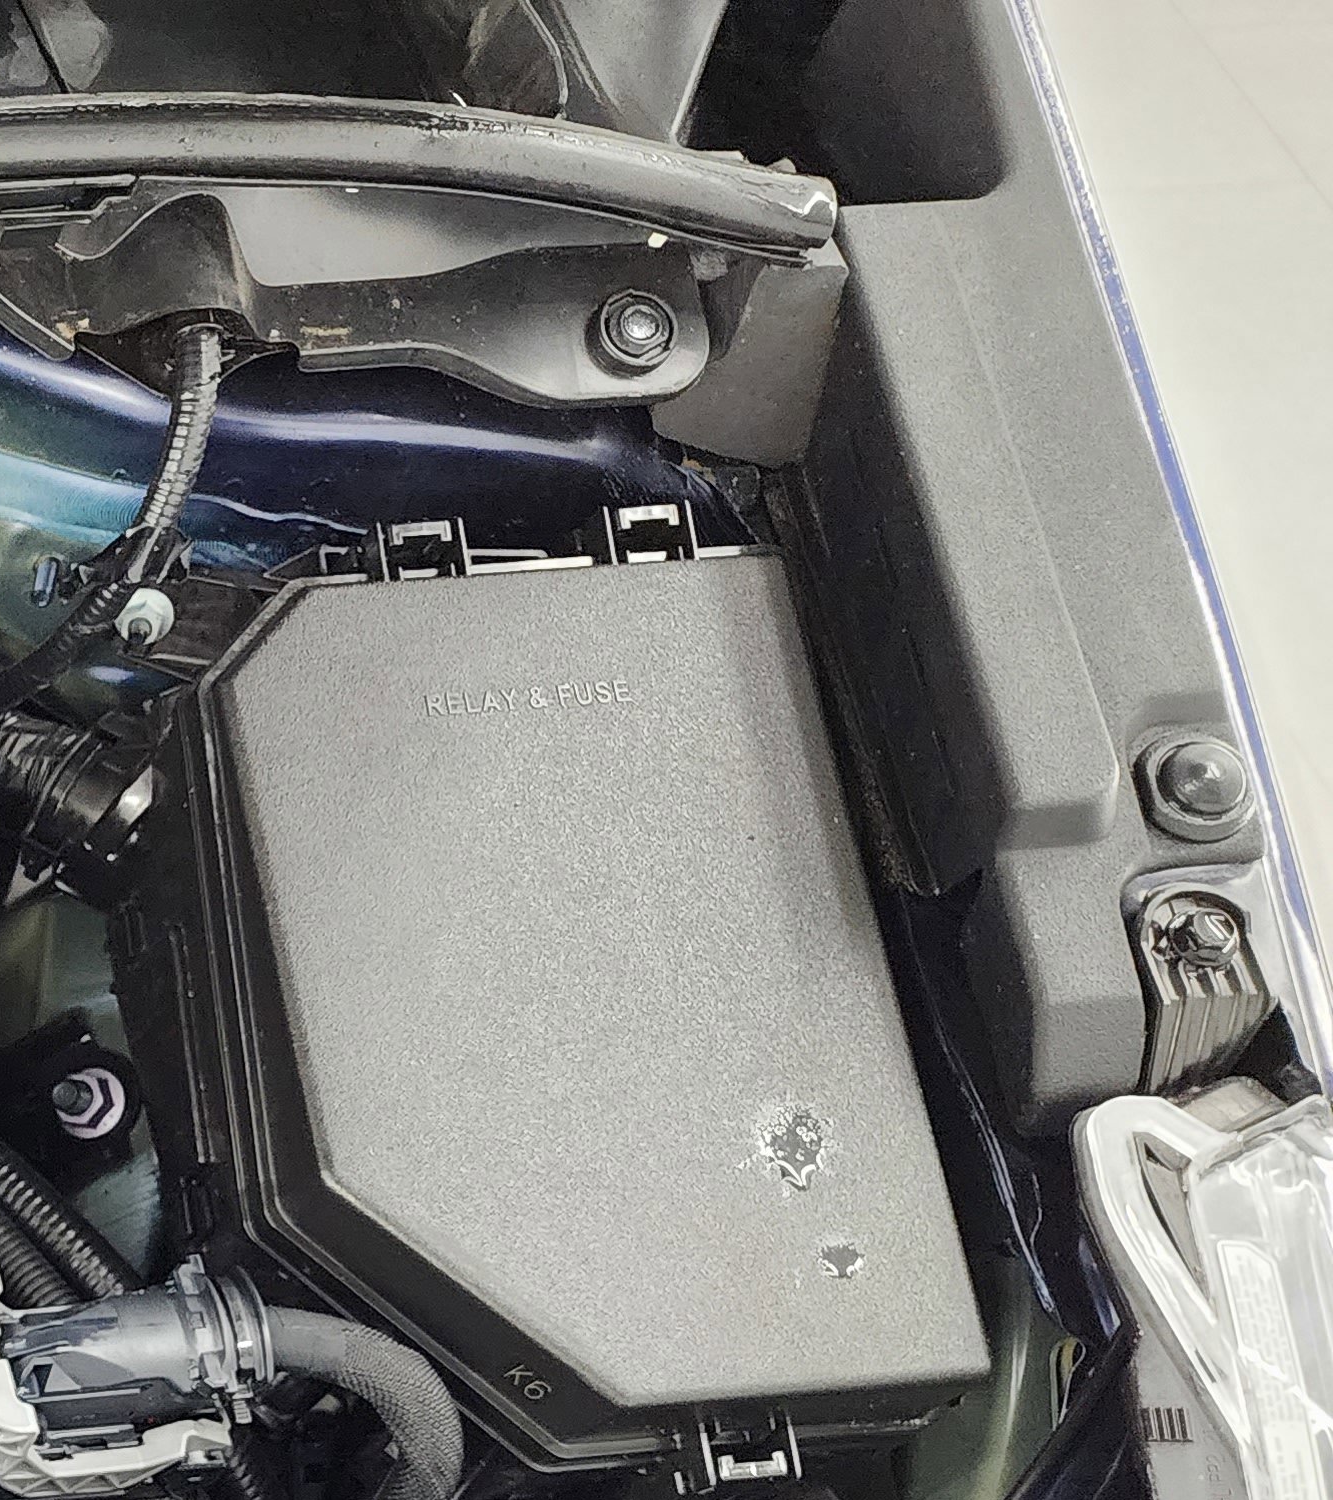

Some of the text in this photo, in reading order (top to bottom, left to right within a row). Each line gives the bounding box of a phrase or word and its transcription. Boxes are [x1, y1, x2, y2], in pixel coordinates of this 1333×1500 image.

[424, 680, 633, 716] RELAY & FUSE
[502, 1364, 553, 1398] K6
